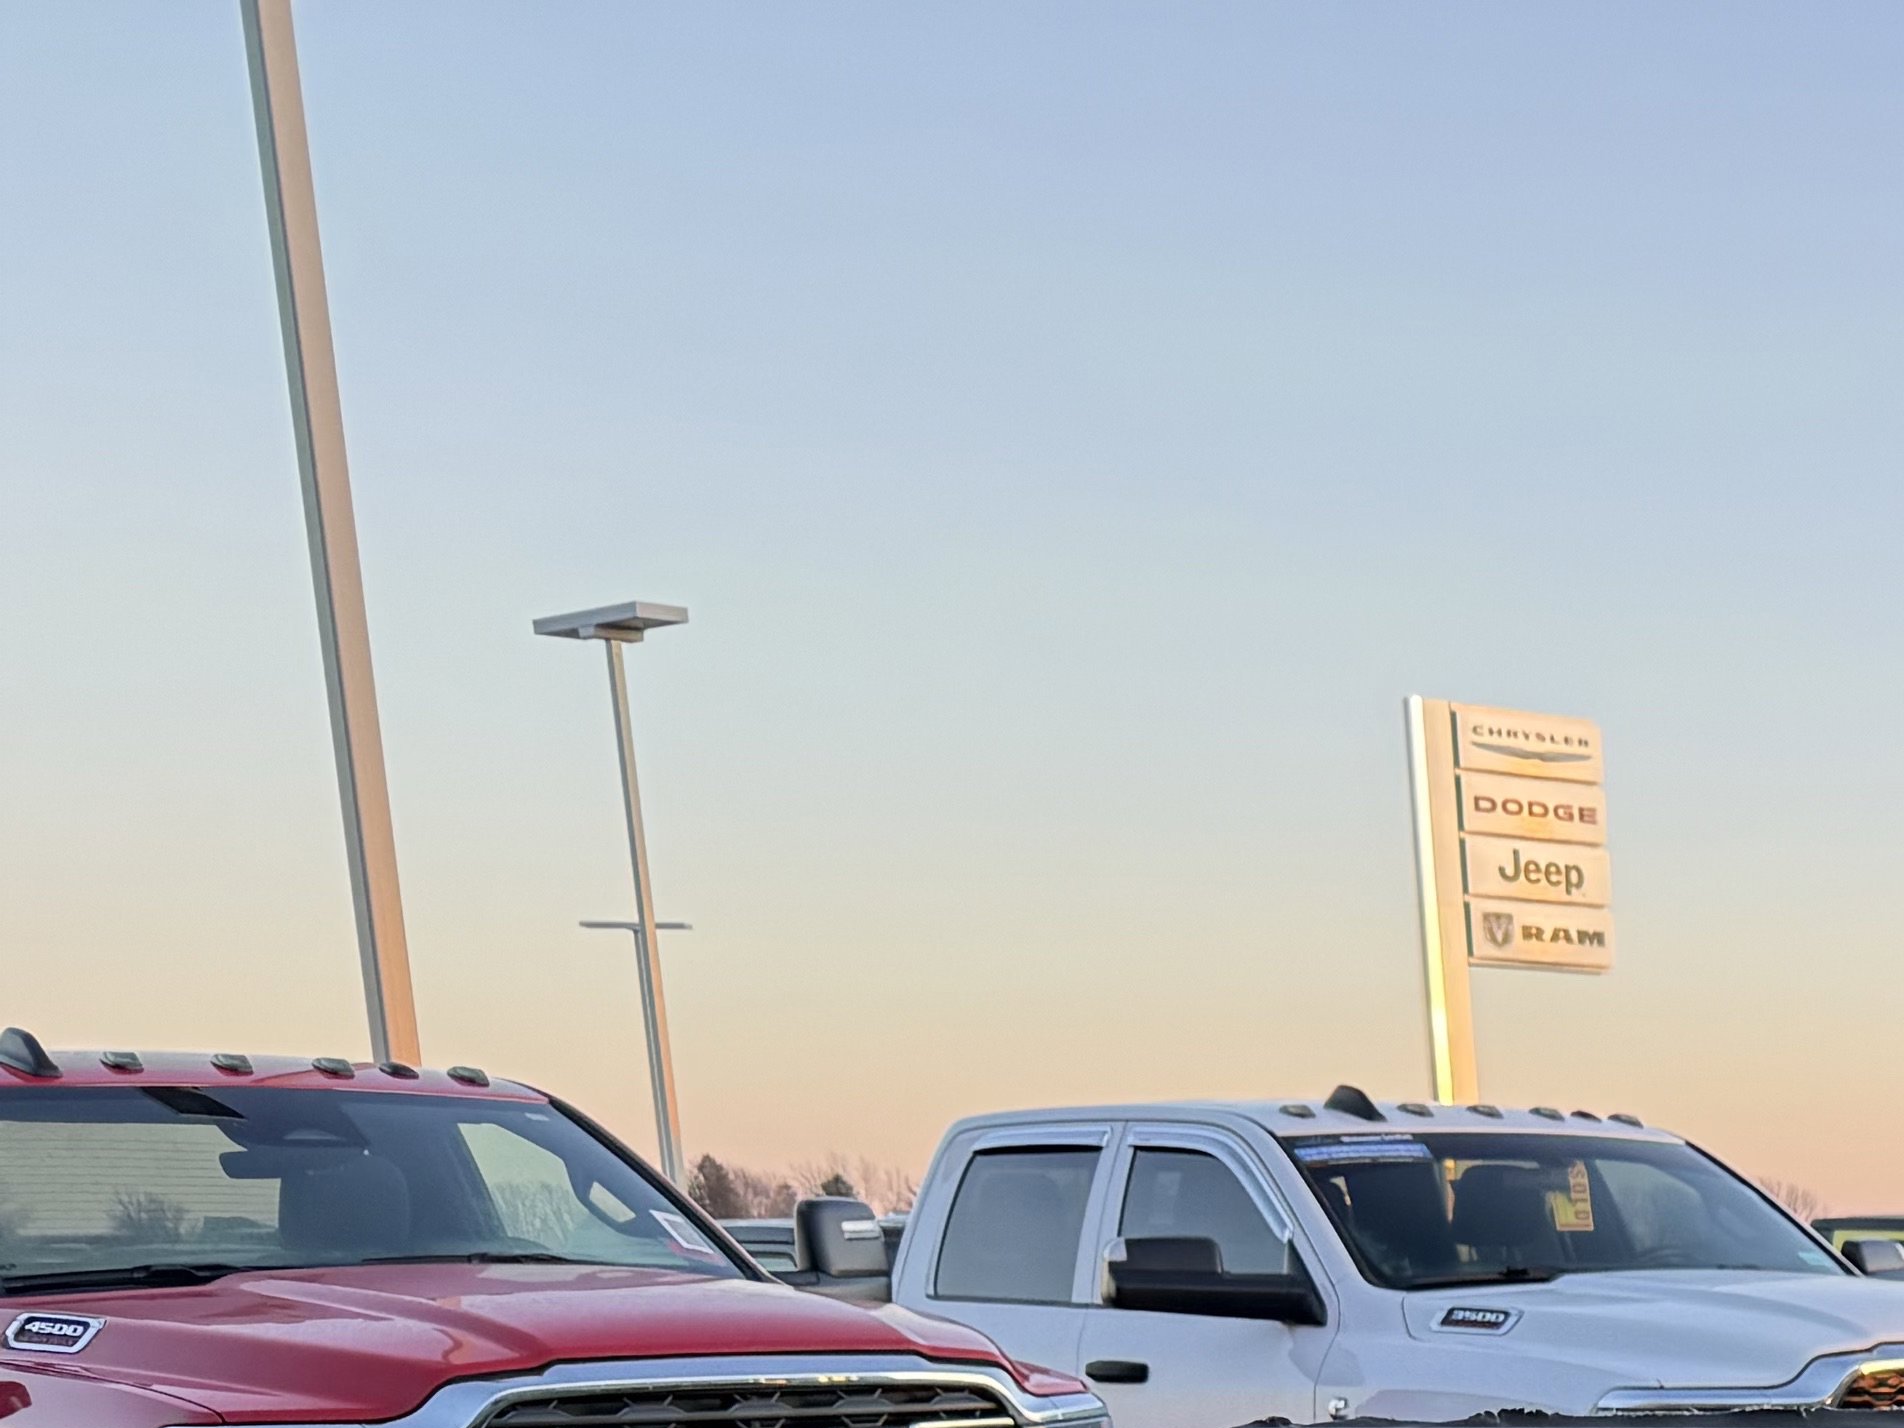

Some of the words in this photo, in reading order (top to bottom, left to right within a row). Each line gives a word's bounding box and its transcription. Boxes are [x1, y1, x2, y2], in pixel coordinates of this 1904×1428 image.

[1472, 724, 1590, 748] CHRYSLER
[1473, 796, 1598, 825] DODGE
[1498, 849, 1585, 896] Jeep
[1521, 924, 1606, 948] RAM
[24, 1321, 84, 1337] 4500
